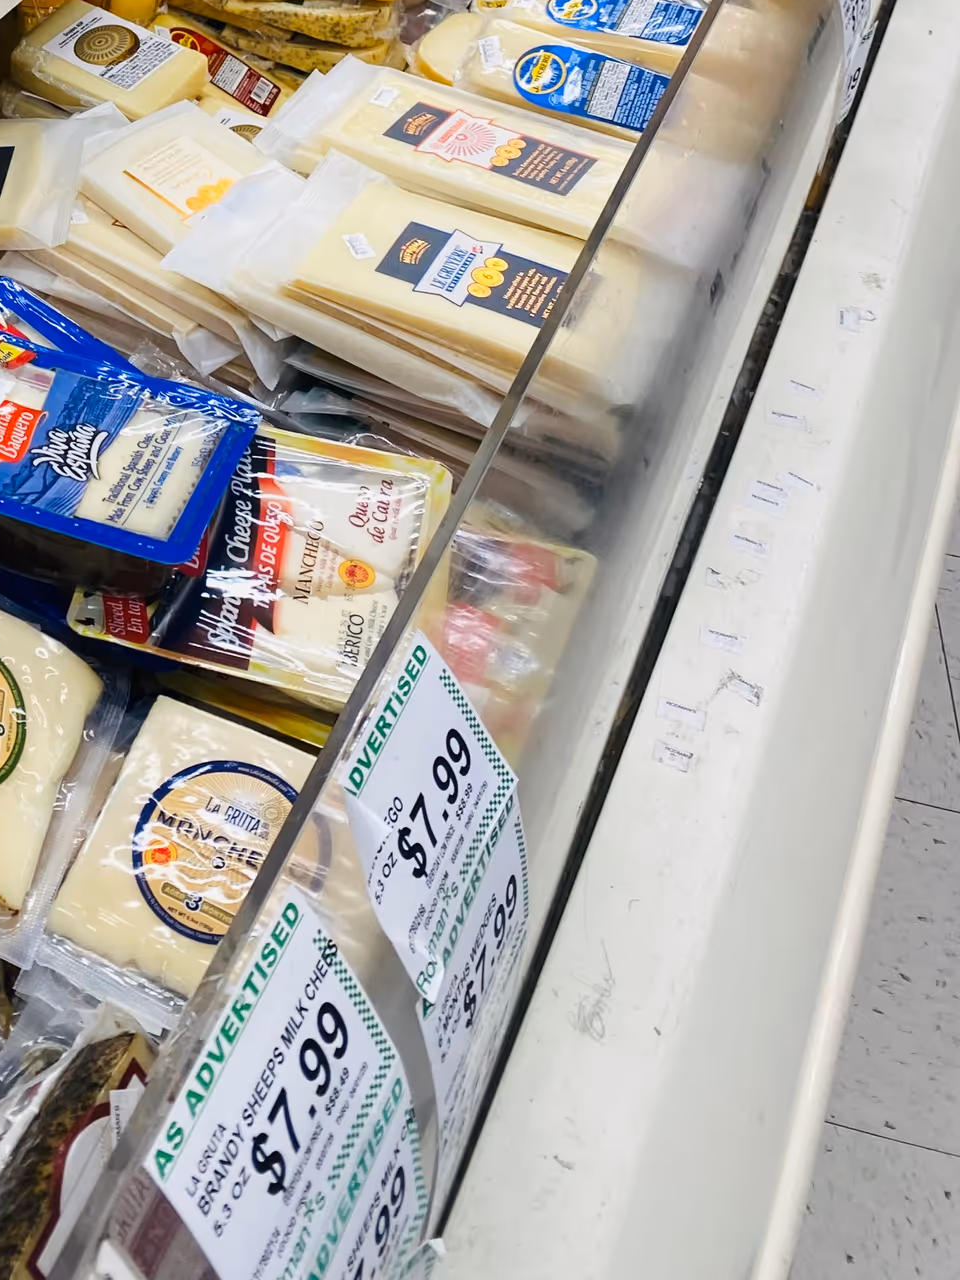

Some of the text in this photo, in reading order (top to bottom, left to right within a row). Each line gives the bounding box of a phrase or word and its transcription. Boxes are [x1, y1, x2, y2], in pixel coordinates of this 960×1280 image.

[31, 428, 67, 468] Viva
[49, 422, 106, 482] España
[102, 450, 145, 504] Traditional Spanish
[265, 501, 283, 563] DE QUESO
[293, 519, 325, 606] MANCHEGO
[205, 797, 261, 836] LA GRUTA
[398, 728, 472, 880] $7.99
[382, 850, 400, 879] OZ
[442, 796, 516, 971] ADVERTISED
[185, 895, 203, 912] 3
[469, 892, 498, 962] WEDGES
[463, 874, 518, 1029] $7.99
[154, 904, 303, 1181] AS ADVERTISED
[197, 1123, 247, 1217] BRANDY
[242, 1045, 286, 1128] SHEEPS
[280, 999, 310, 1050] MILK
[251, 1001, 350, 1197] $7.99
[185, 1122, 228, 1198] LA GRUTA
[380, 1146, 402, 1192] MILK
